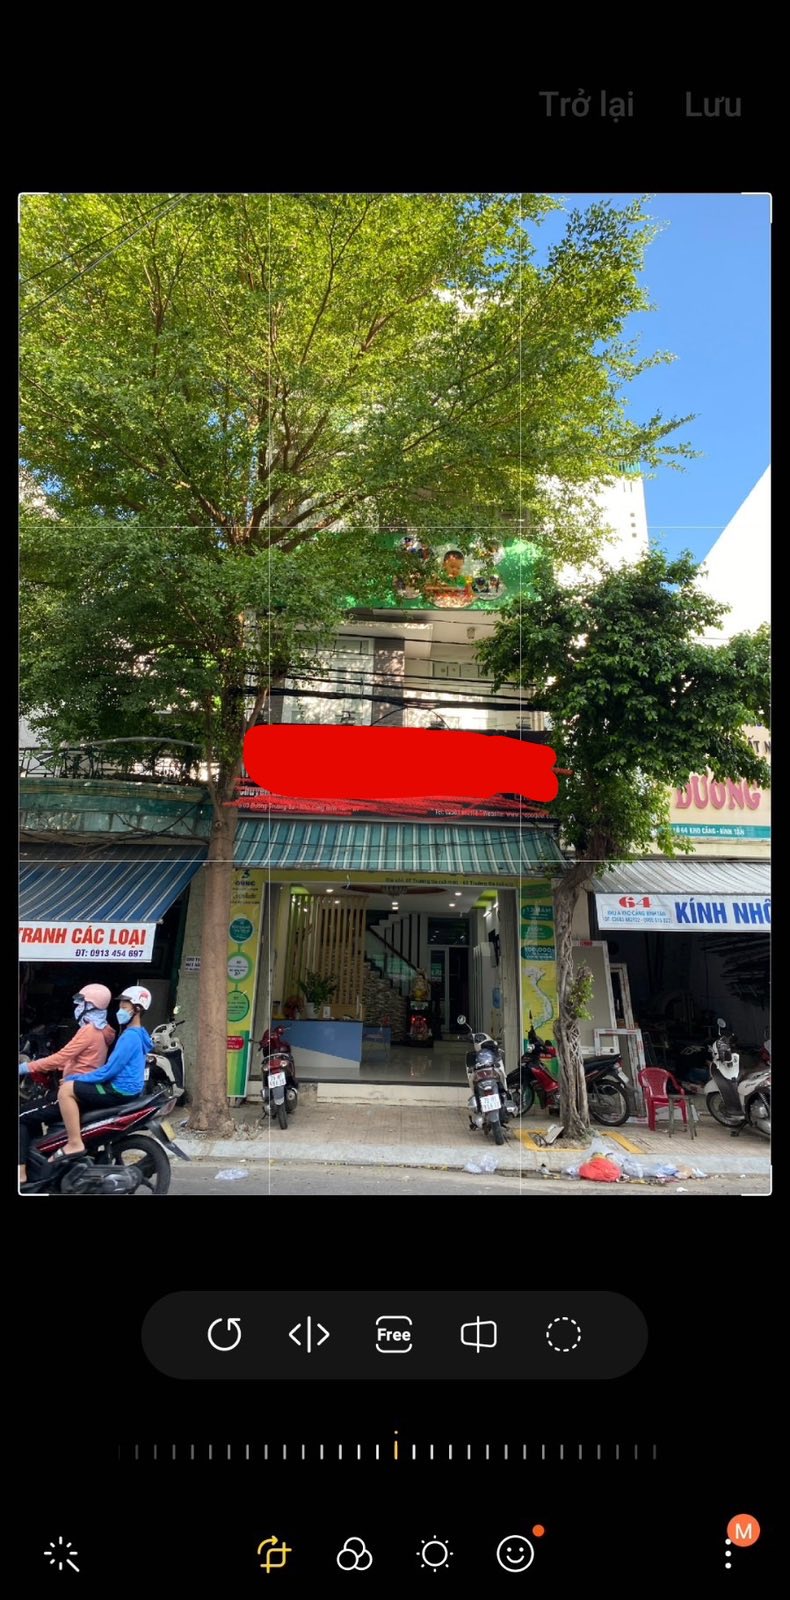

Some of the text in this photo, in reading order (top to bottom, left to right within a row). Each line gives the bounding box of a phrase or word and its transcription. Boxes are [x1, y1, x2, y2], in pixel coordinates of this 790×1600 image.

[619, 895, 652, 909] 64
[675, 897, 727, 924] KÍNH
[19, 925, 147, 948] RANH CÁC LOẠI
[75, 949, 88, 957] ĐT:
[90, 949, 110, 957] 0913
[111, 949, 126, 957] 454
